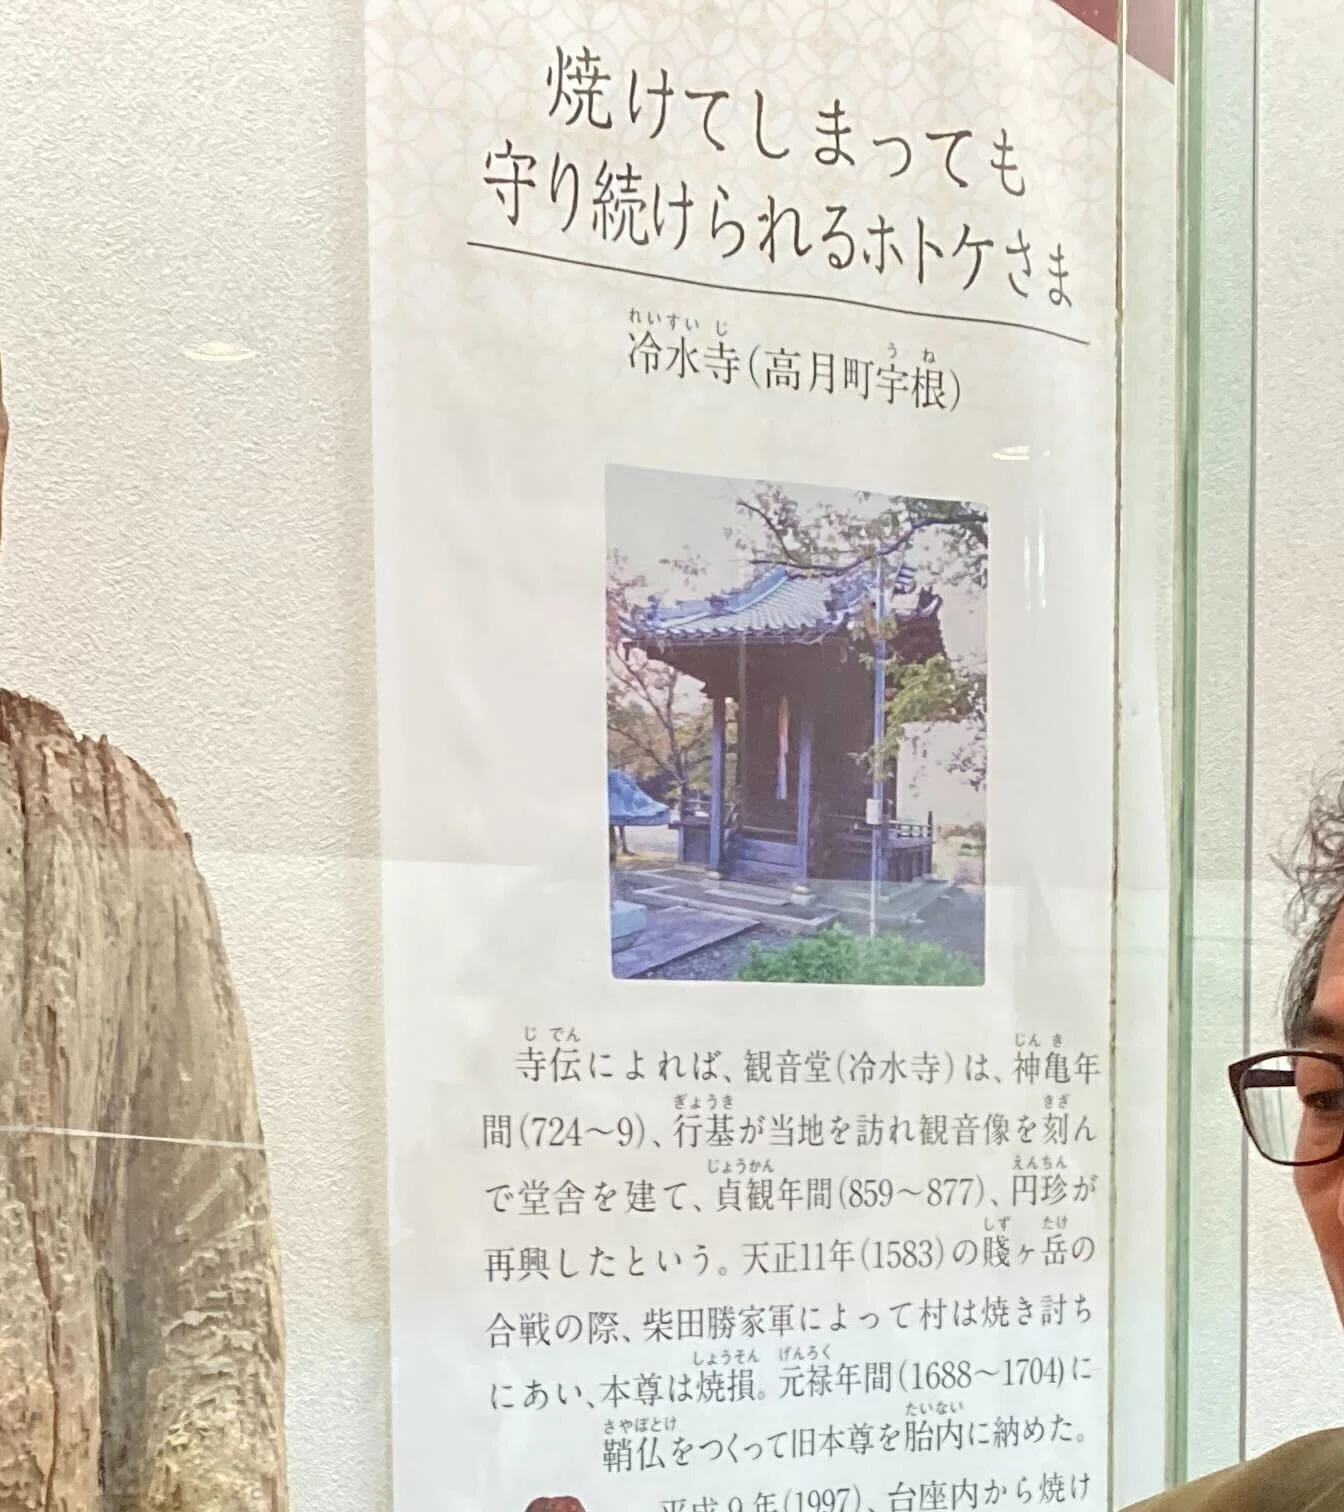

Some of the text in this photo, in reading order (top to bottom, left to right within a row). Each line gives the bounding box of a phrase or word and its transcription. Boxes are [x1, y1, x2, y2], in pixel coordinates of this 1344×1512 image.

[547, 45, 1025, 196] 焼けてしまっても
[483, 141, 1072, 308] 守り続けられるホトケさま
[629, 307, 729, 337] れいすい じ
[628, 331, 961, 411] 冷水寺(高月町宇根)
[549, 1027, 581, 1042] でん
[674, 1094, 733, 1110] ぎょうき
[708, 1155, 1068, 1174] じょうかん えんちん
[984, 1216, 1067, 1231] しず たけ
[487, 1293, 1091, 1348] 合戦の際、柴田勝家軍によって村は焼き討ち
[693, 1344, 831, 1366] しょうそん げんろく
[905, 1401, 964, 1416] たいない
[604, 1416, 676, 1433] さやぼとけ
[603, 1414, 1084, 1472] 鞘仏をつくって旧本尊を胎内に納めた。
